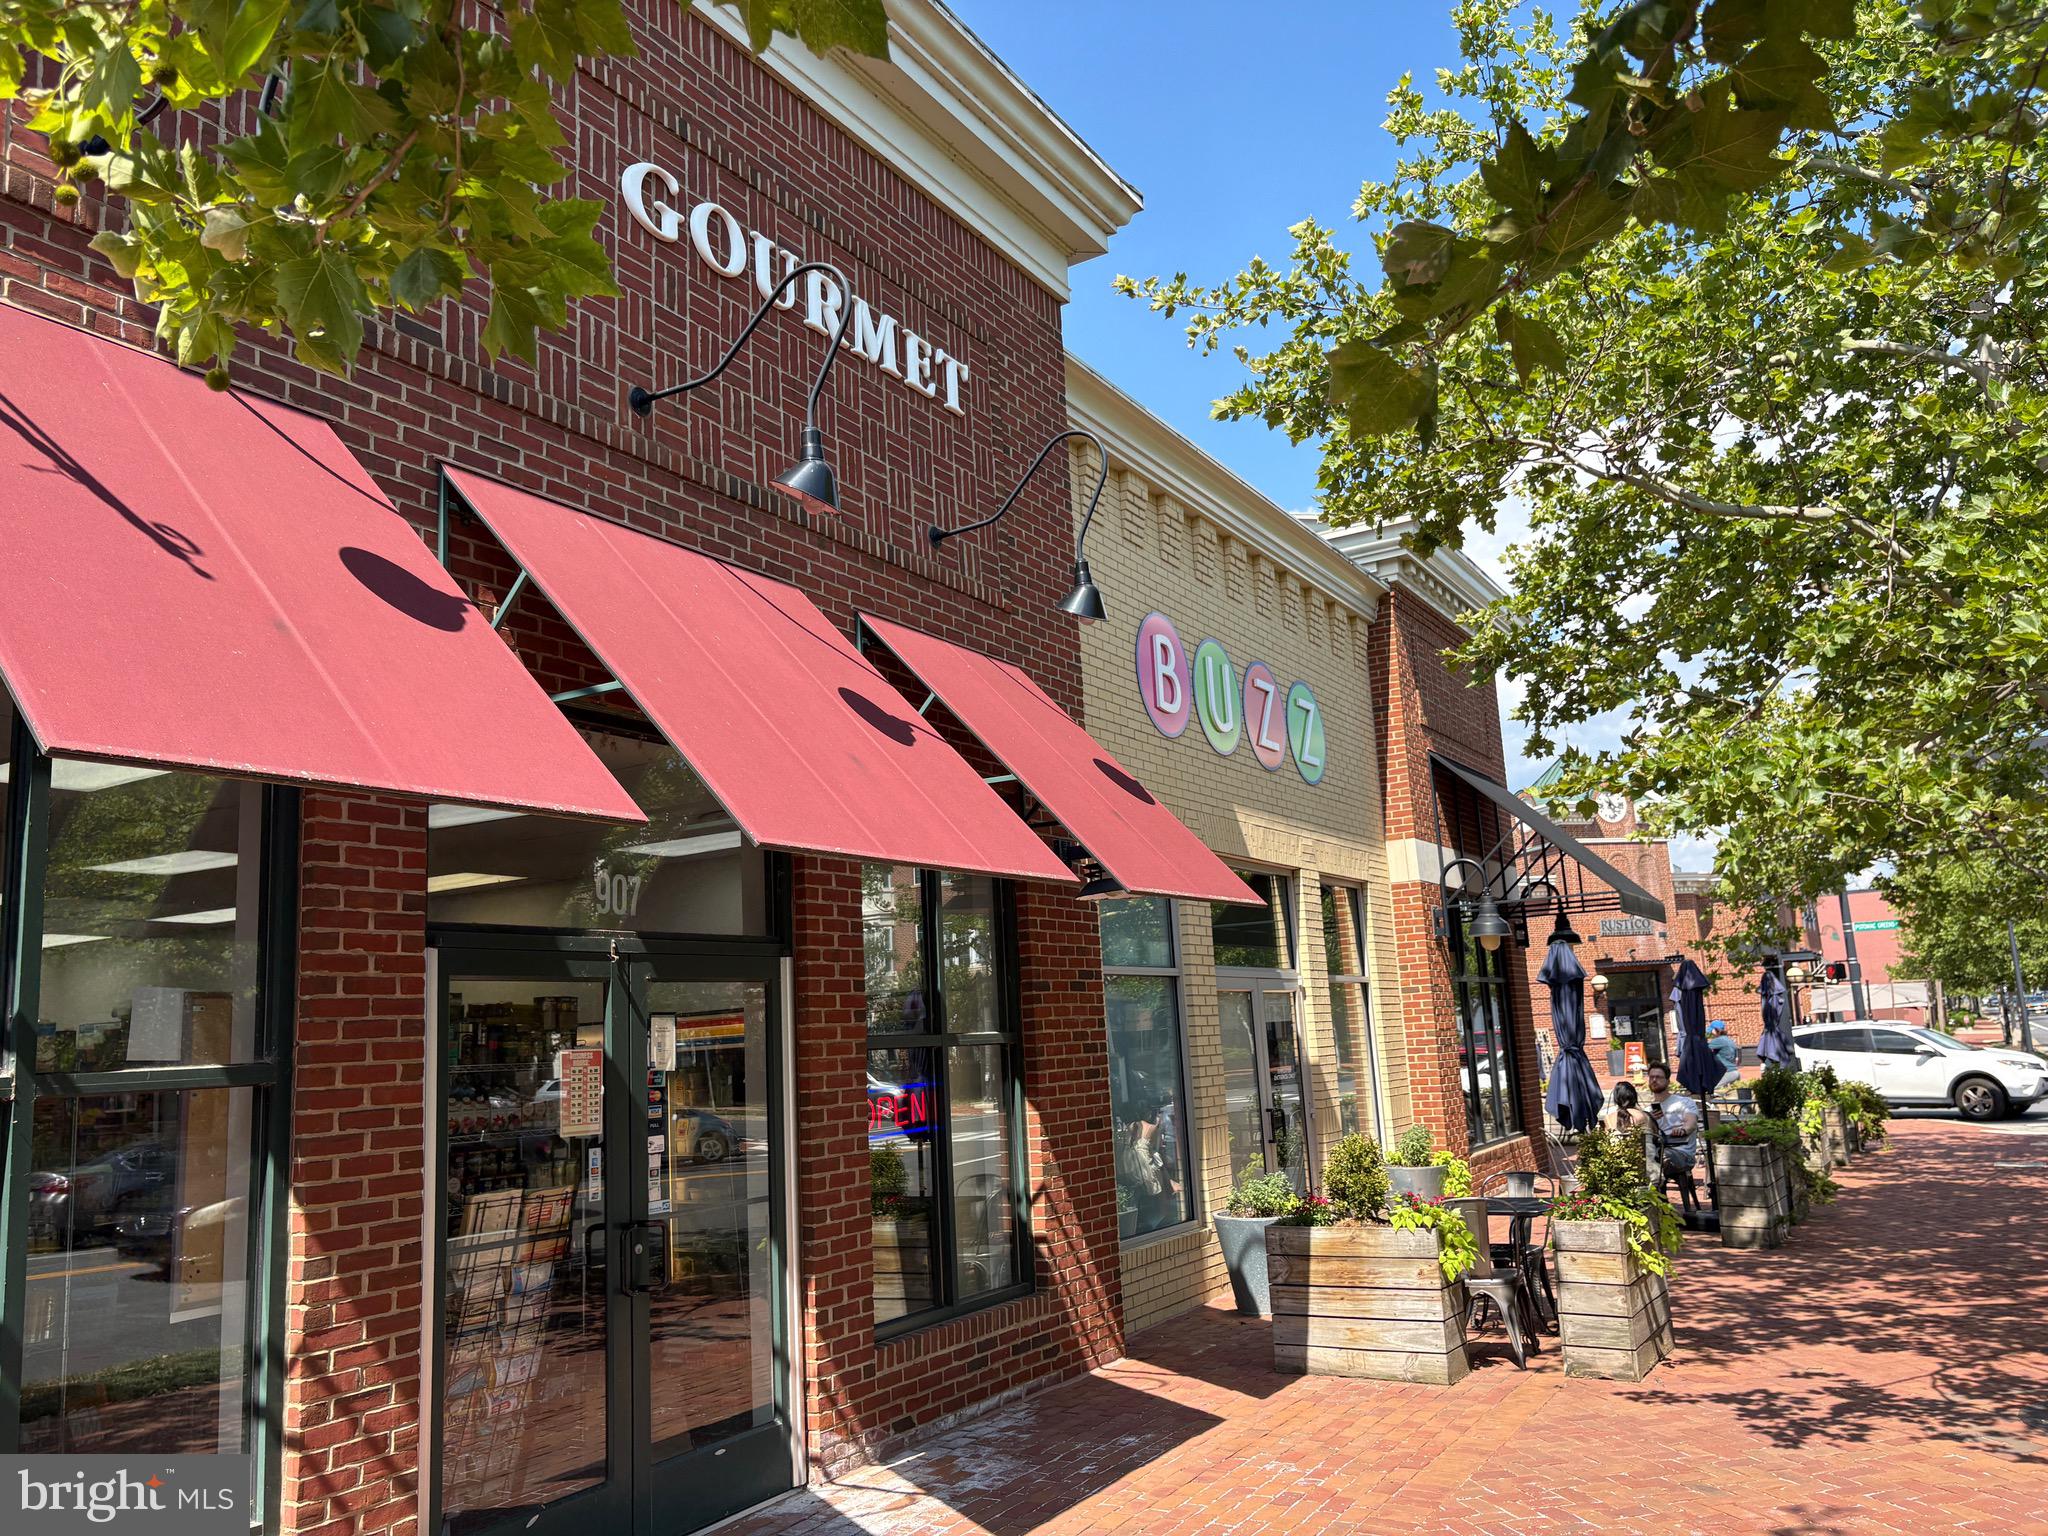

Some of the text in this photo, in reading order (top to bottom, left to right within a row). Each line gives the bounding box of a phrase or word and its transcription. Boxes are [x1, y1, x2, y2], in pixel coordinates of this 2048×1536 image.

[621, 162, 969, 417] GOURMET
[1151, 633, 1320, 767] BUZZ
[596, 869, 642, 916] 907
[1600, 918, 1651, 932] RUSTICO
